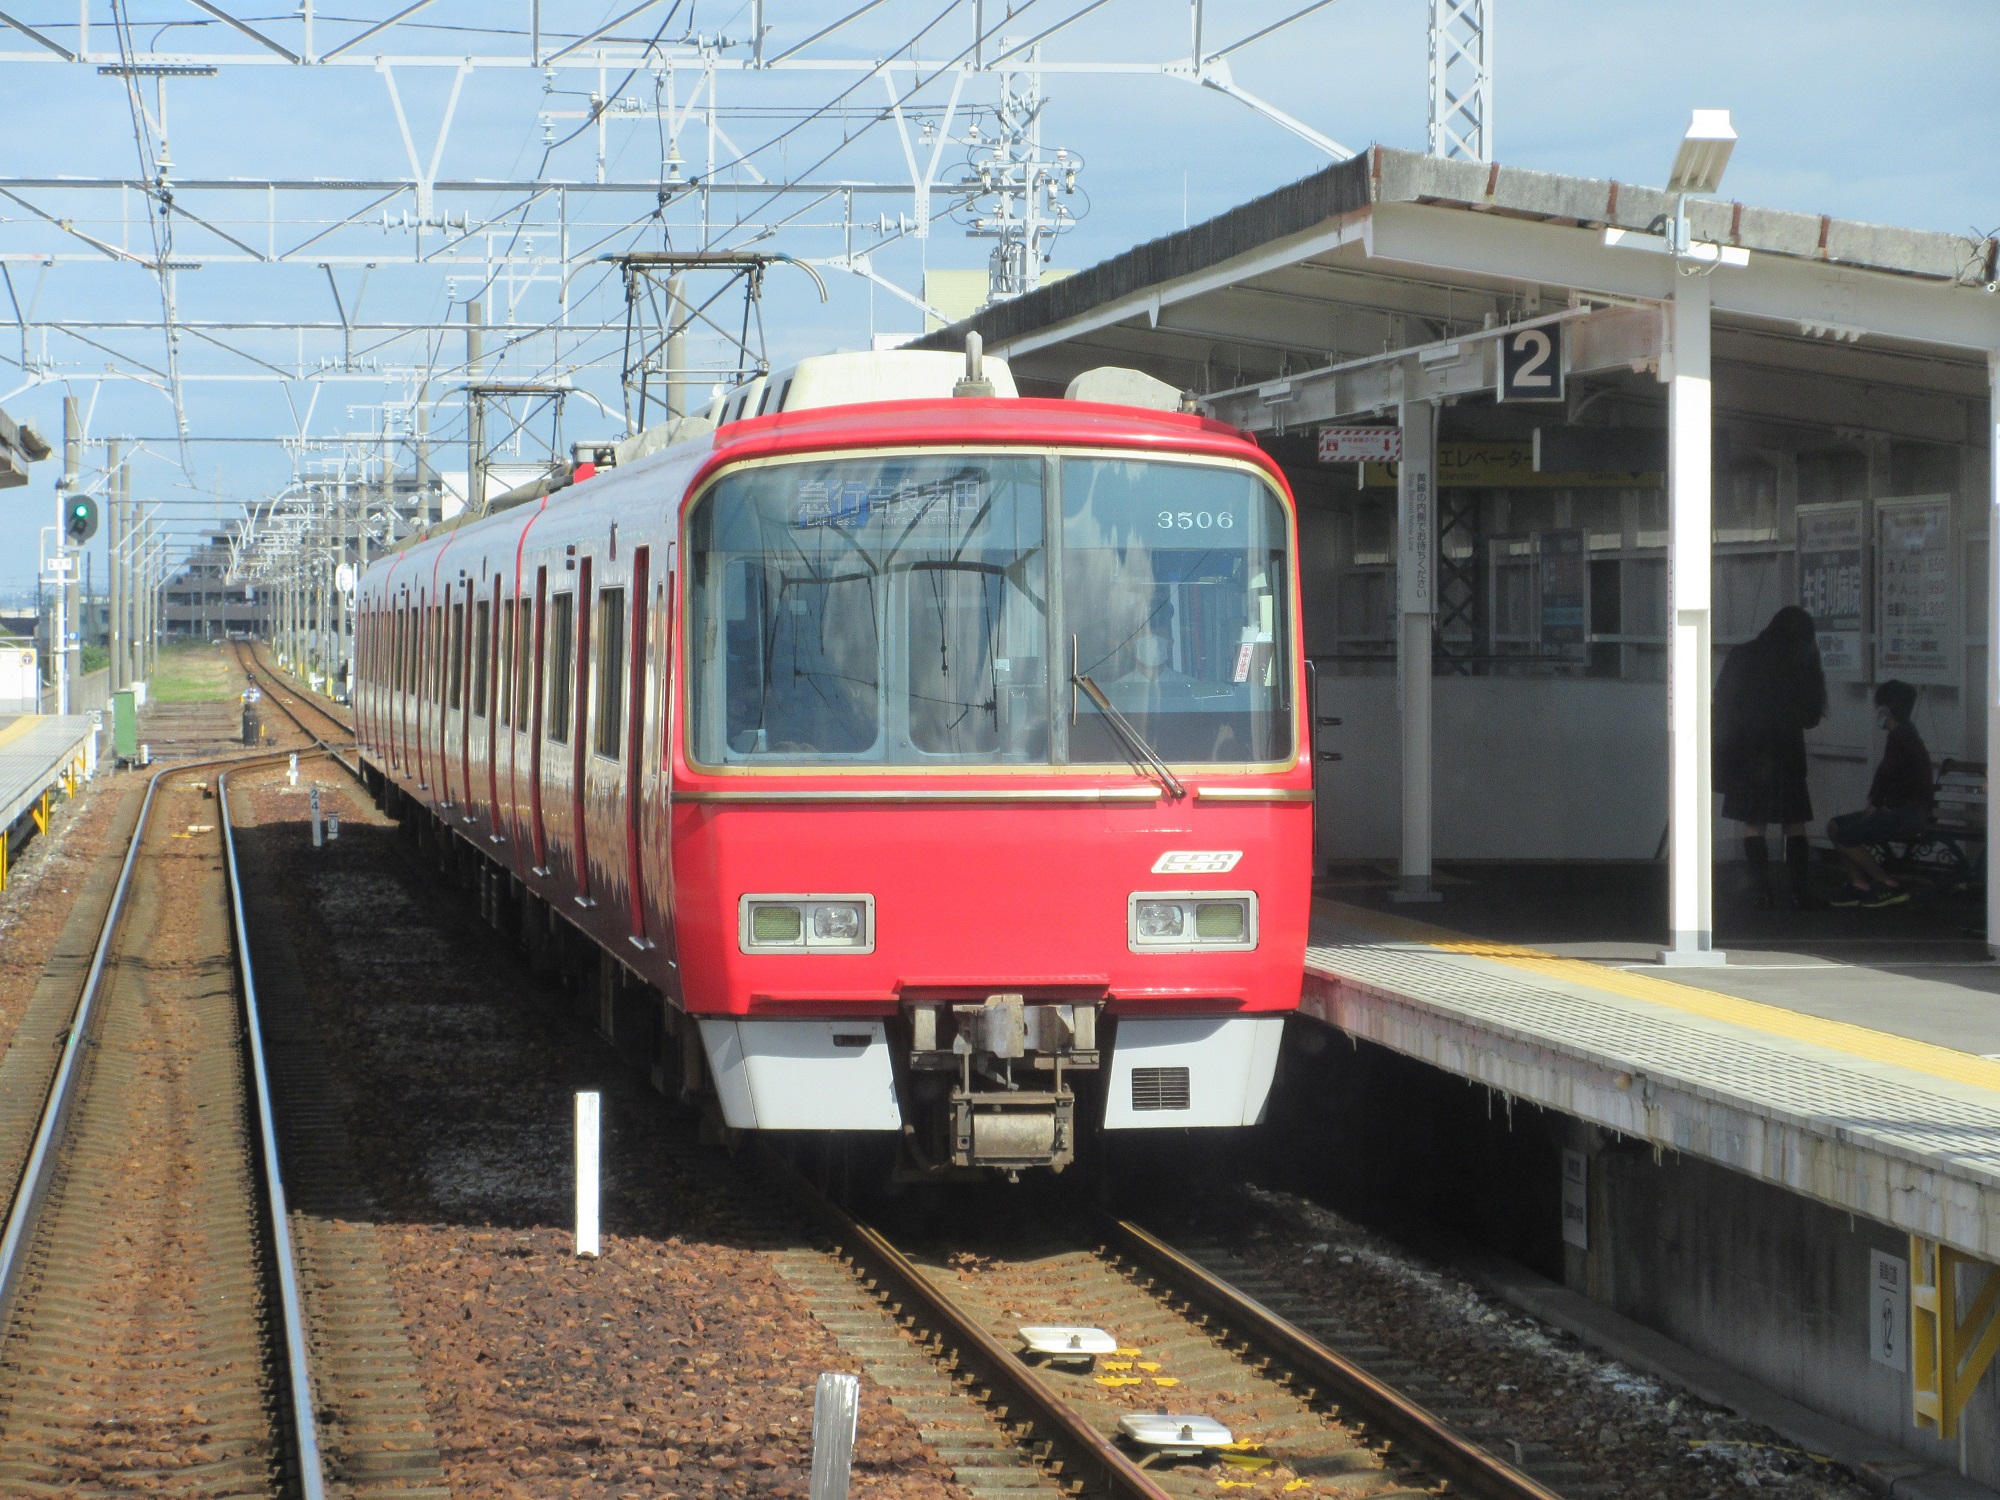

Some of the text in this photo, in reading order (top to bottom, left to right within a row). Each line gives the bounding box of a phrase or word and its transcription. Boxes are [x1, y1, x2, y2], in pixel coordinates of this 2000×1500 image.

[1512, 328, 1551, 387] 2
[798, 479, 980, 514] 急行 吉良吉田
[806, 515, 857, 526] Express
[1157, 511, 1235, 531] 3506
